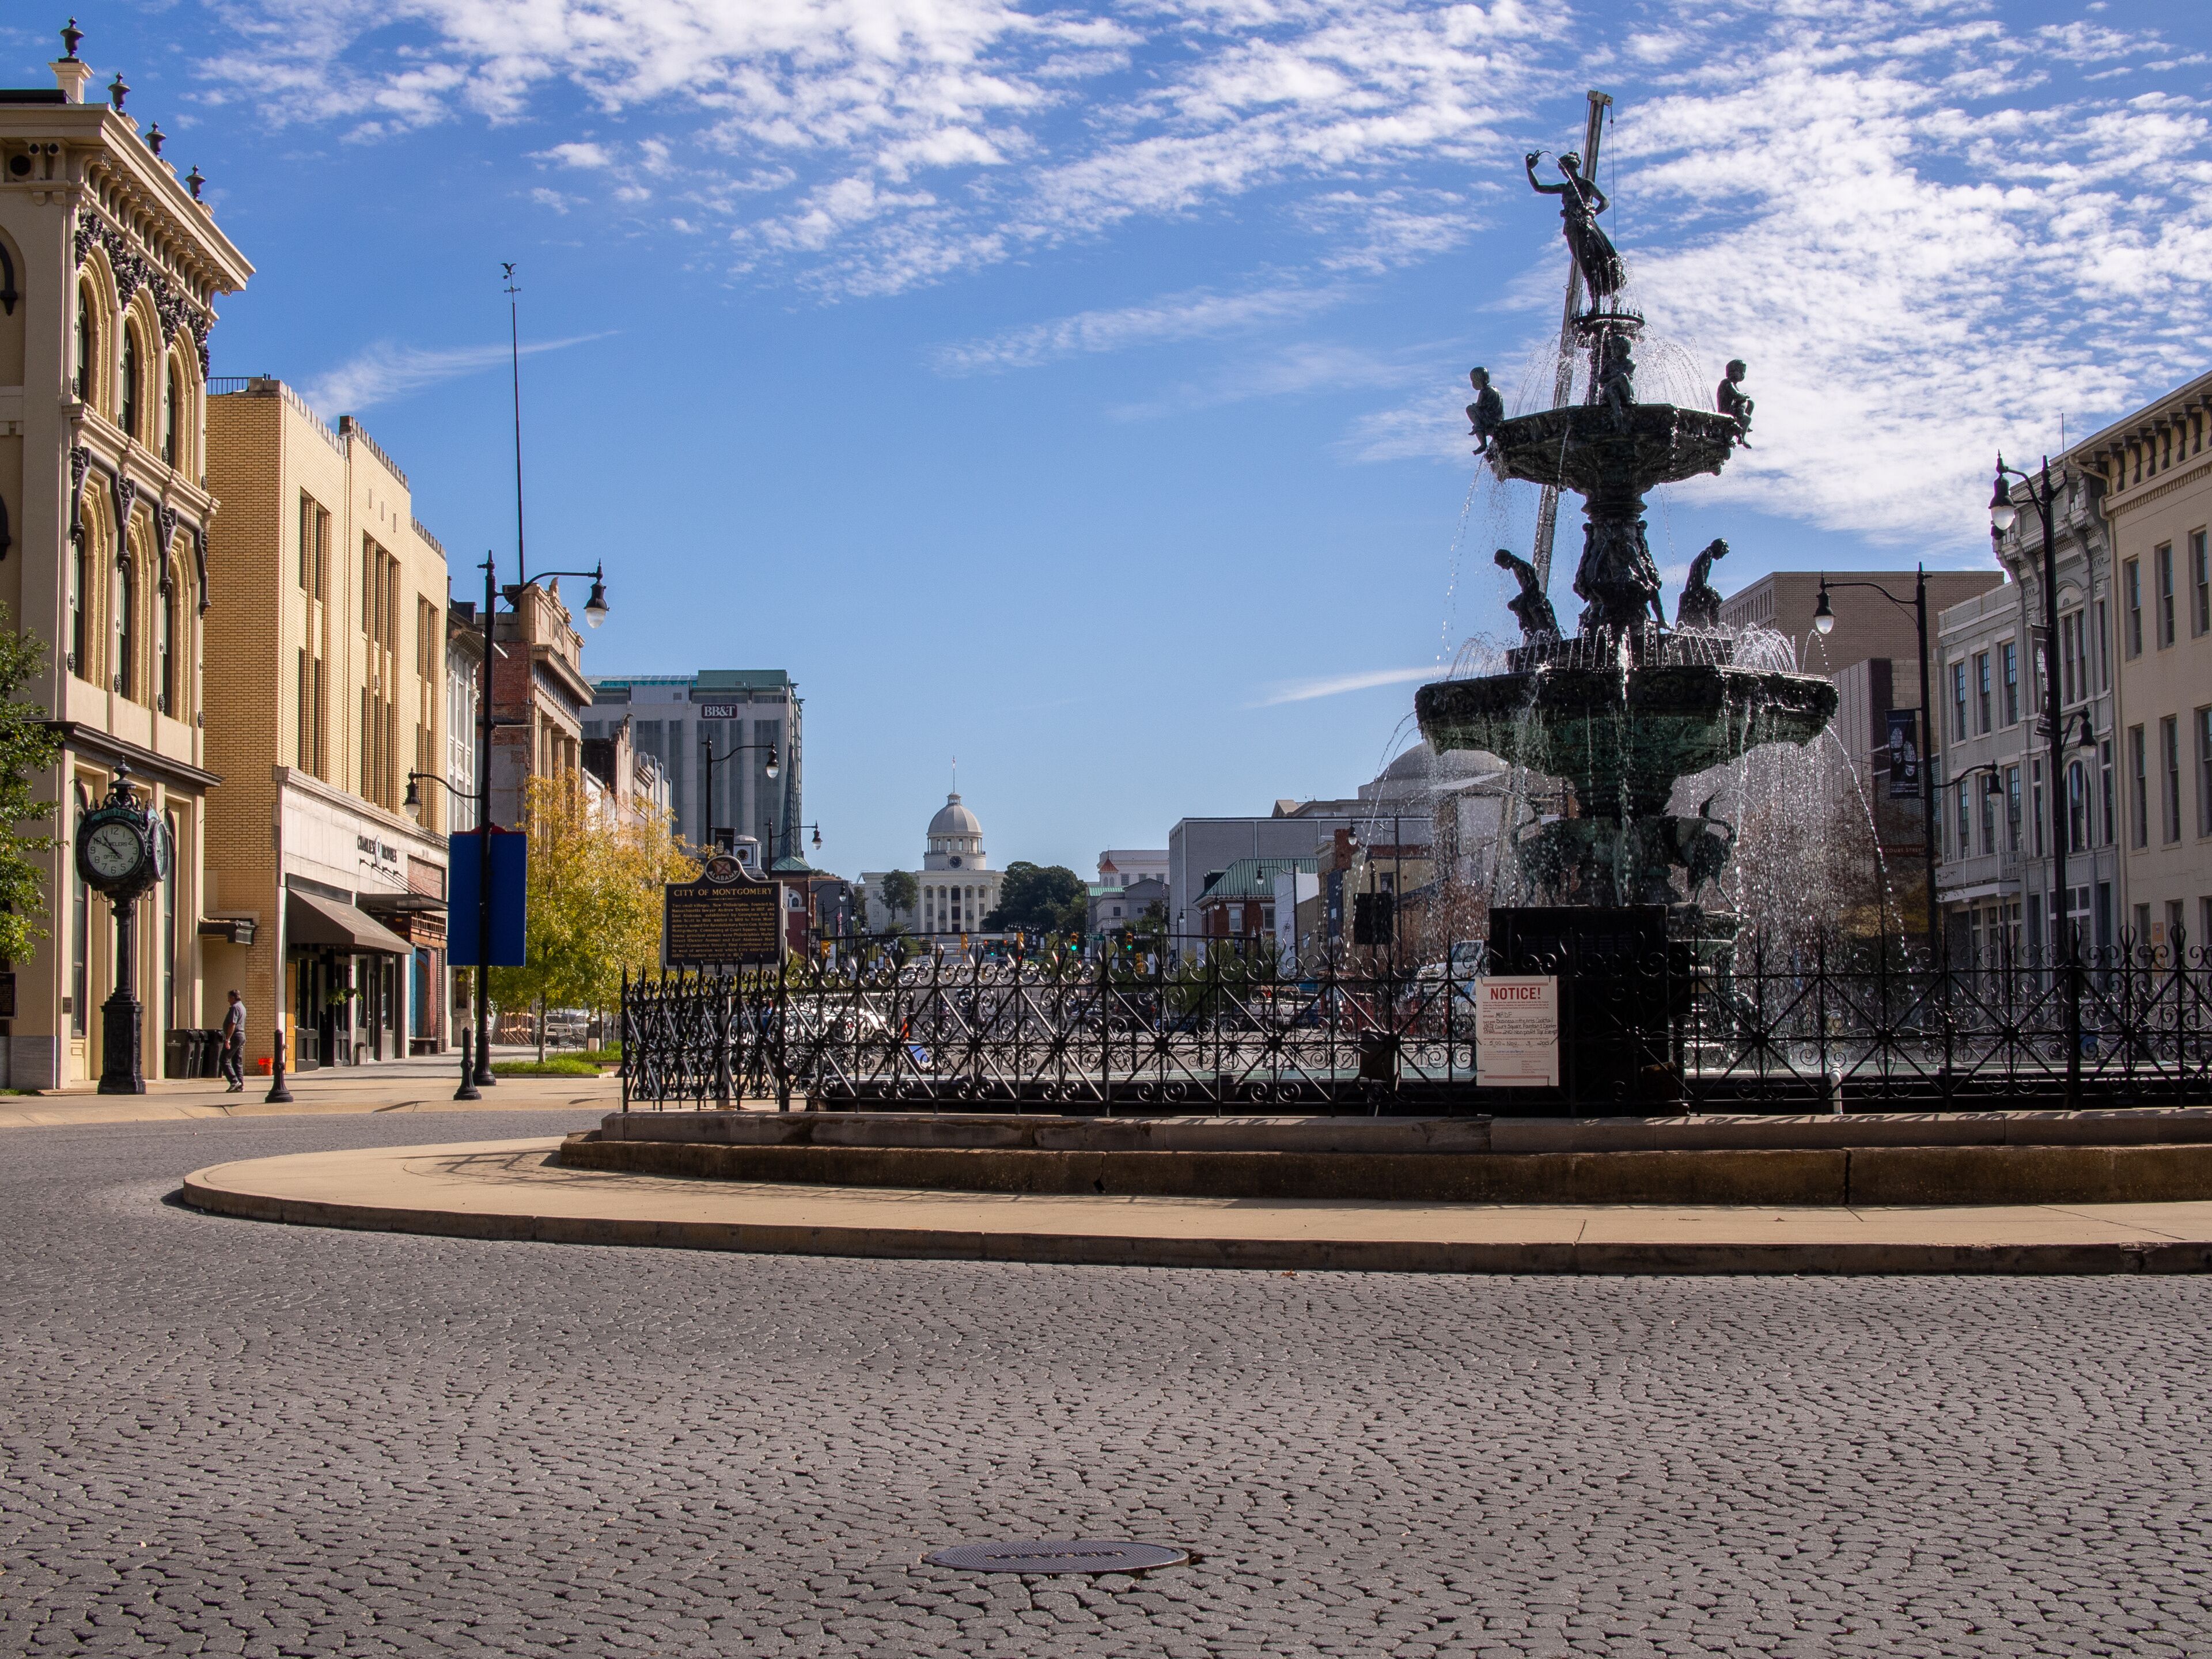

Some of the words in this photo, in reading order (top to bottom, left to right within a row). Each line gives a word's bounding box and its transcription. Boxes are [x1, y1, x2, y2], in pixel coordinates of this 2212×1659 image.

[704, 706, 735, 717] BB&T
[708, 870, 739, 881] ALABAMA
[1491, 988, 1541, 1000] NOTICE!
